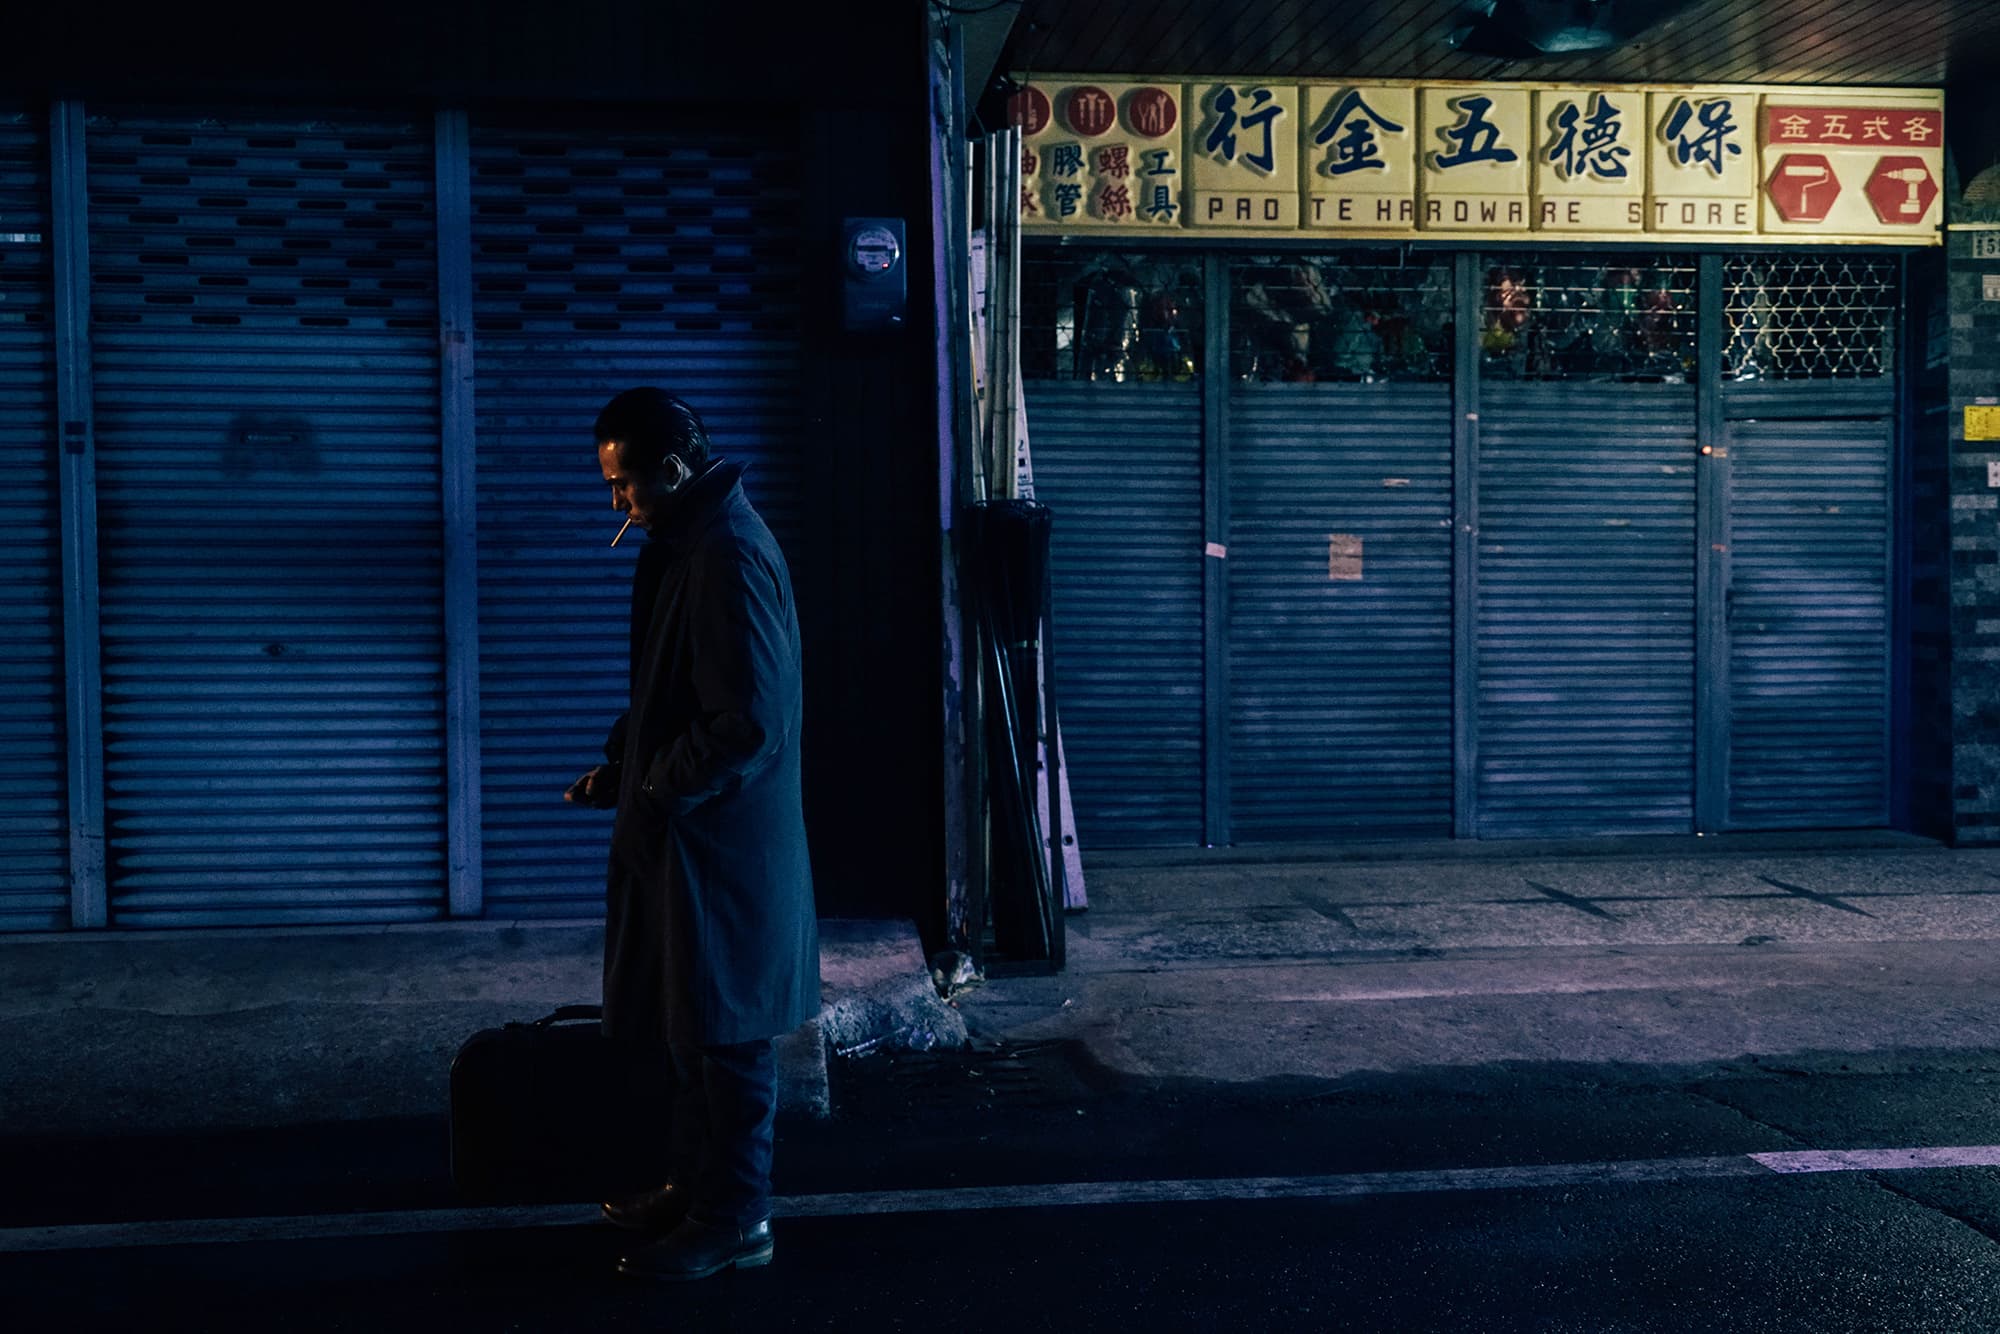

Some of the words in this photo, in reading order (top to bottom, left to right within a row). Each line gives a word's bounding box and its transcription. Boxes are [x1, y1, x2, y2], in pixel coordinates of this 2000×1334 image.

[1052, 145, 1085, 217] 膠管
[1099, 146, 1132, 217] 螺絲
[1147, 151, 1178, 218] 工具
[1208, 197, 1279, 221] PAO
[1311, 198, 1353, 221] TE
[1376, 199, 1581, 223] HARDWARE
[1627, 202, 1748, 225] STORE
